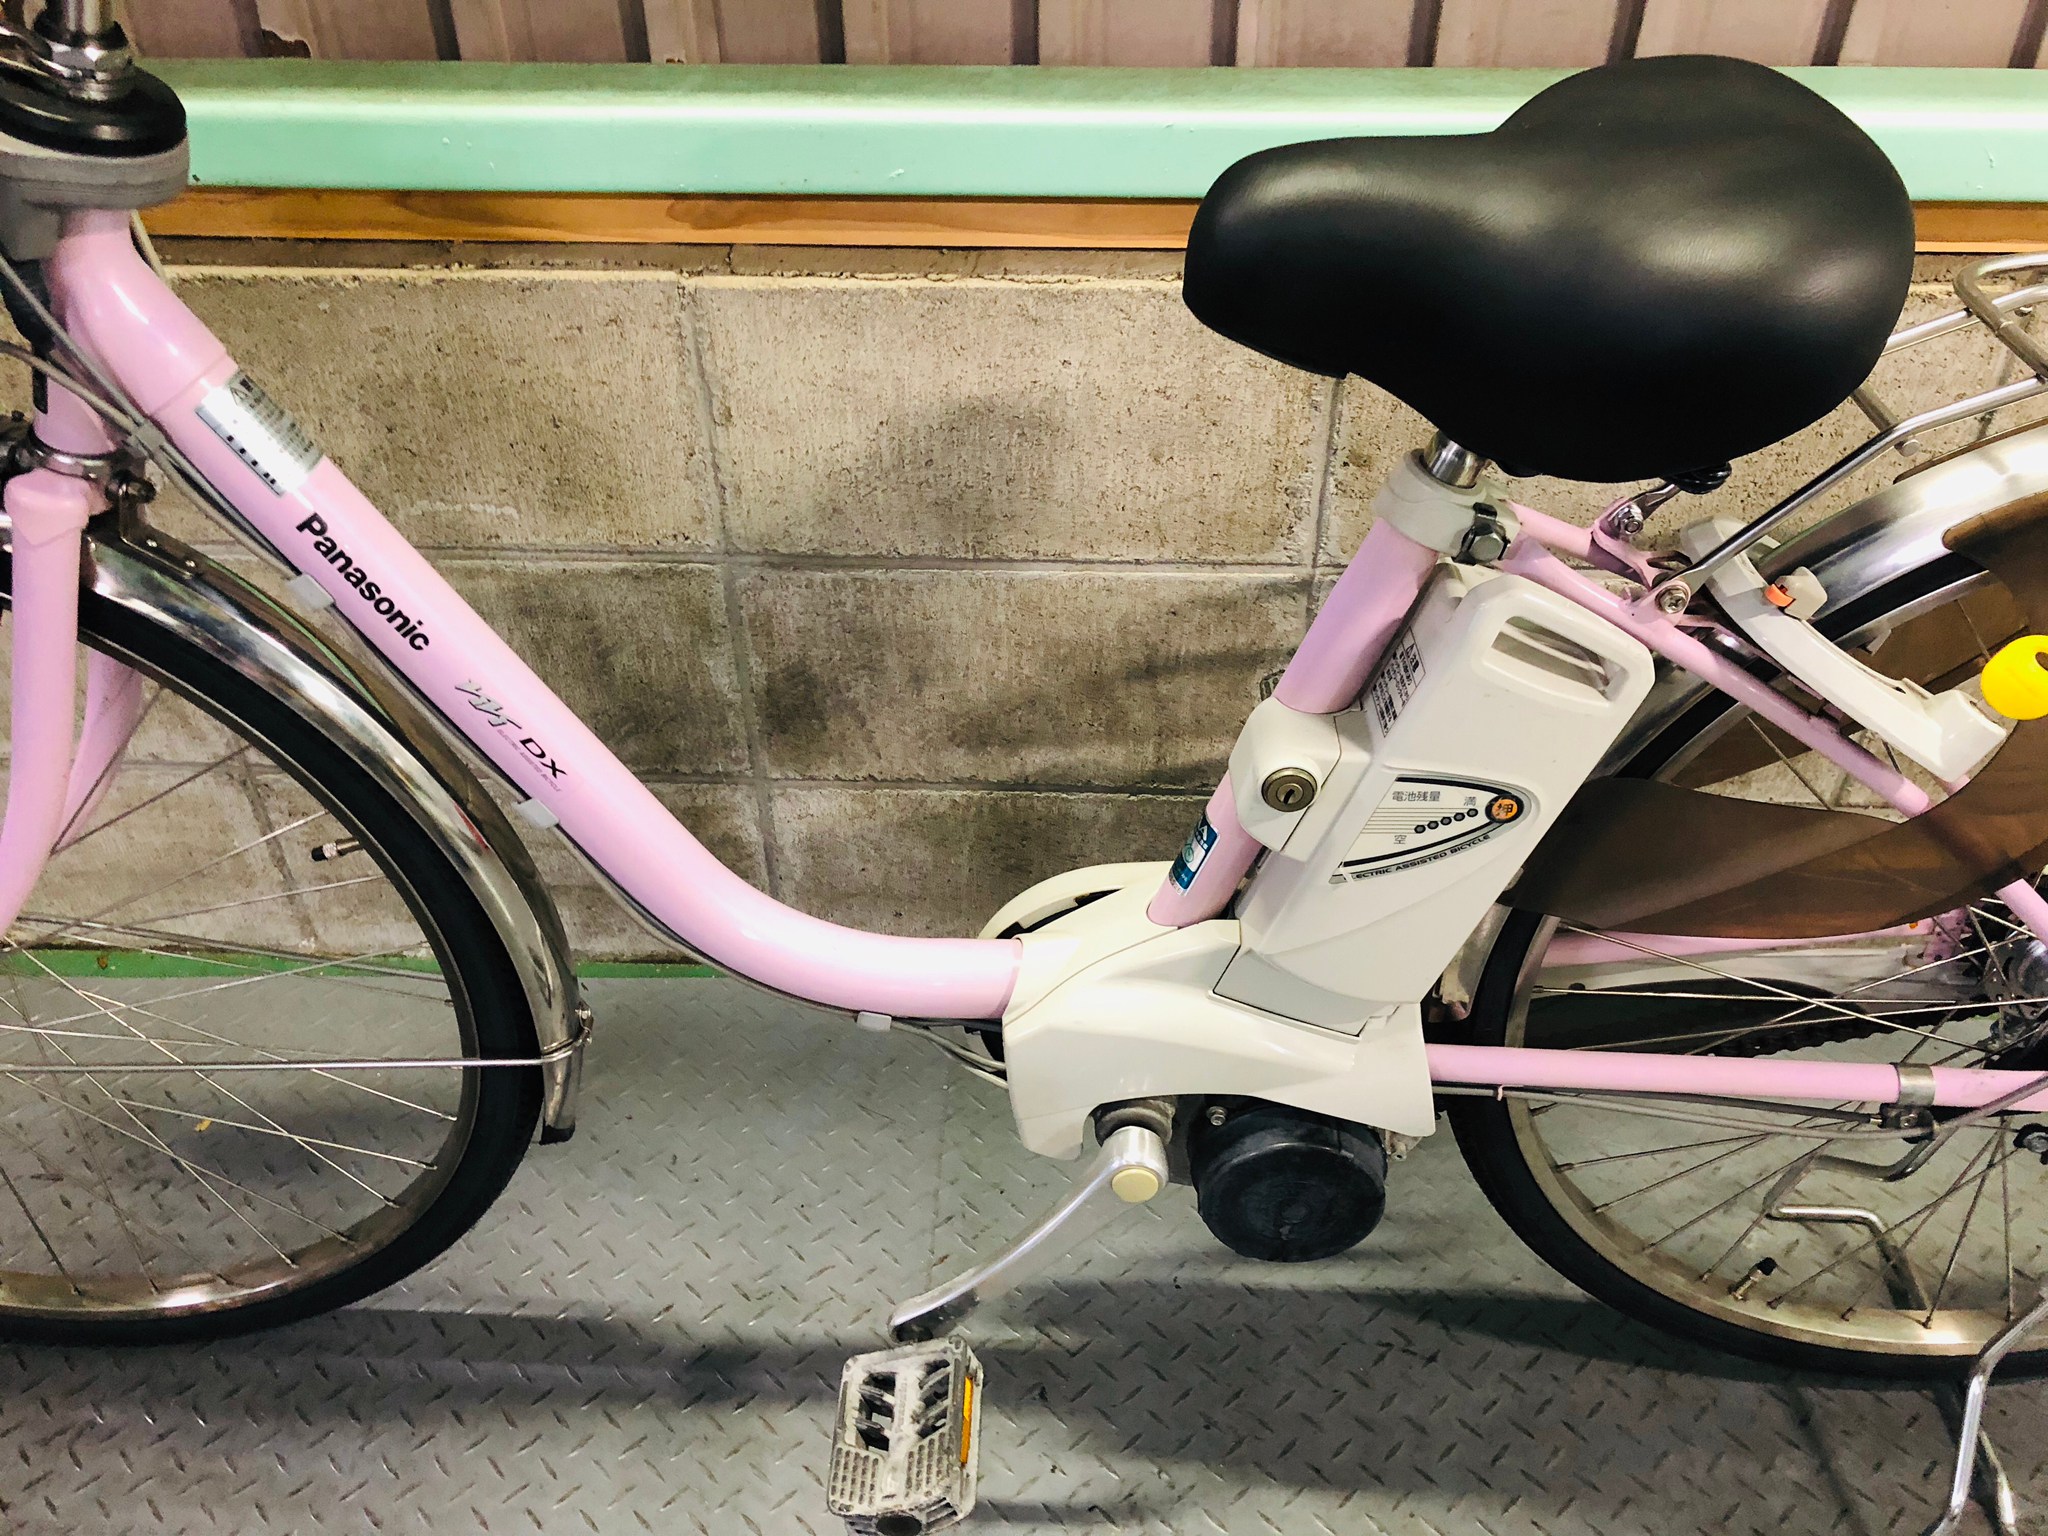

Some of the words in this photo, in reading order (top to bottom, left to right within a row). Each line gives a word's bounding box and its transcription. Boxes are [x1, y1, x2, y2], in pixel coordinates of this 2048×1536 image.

[295, 511, 430, 651] Panasonic
[519, 737, 567, 779] DX
[1392, 790, 1440, 802] 電池残量
[1344, 868, 1392, 881] LECTRIC
[1395, 852, 1448, 872] ASSISTED
[1449, 834, 1491, 854] BICYCLE
[1393, 834, 1407, 845] 空
